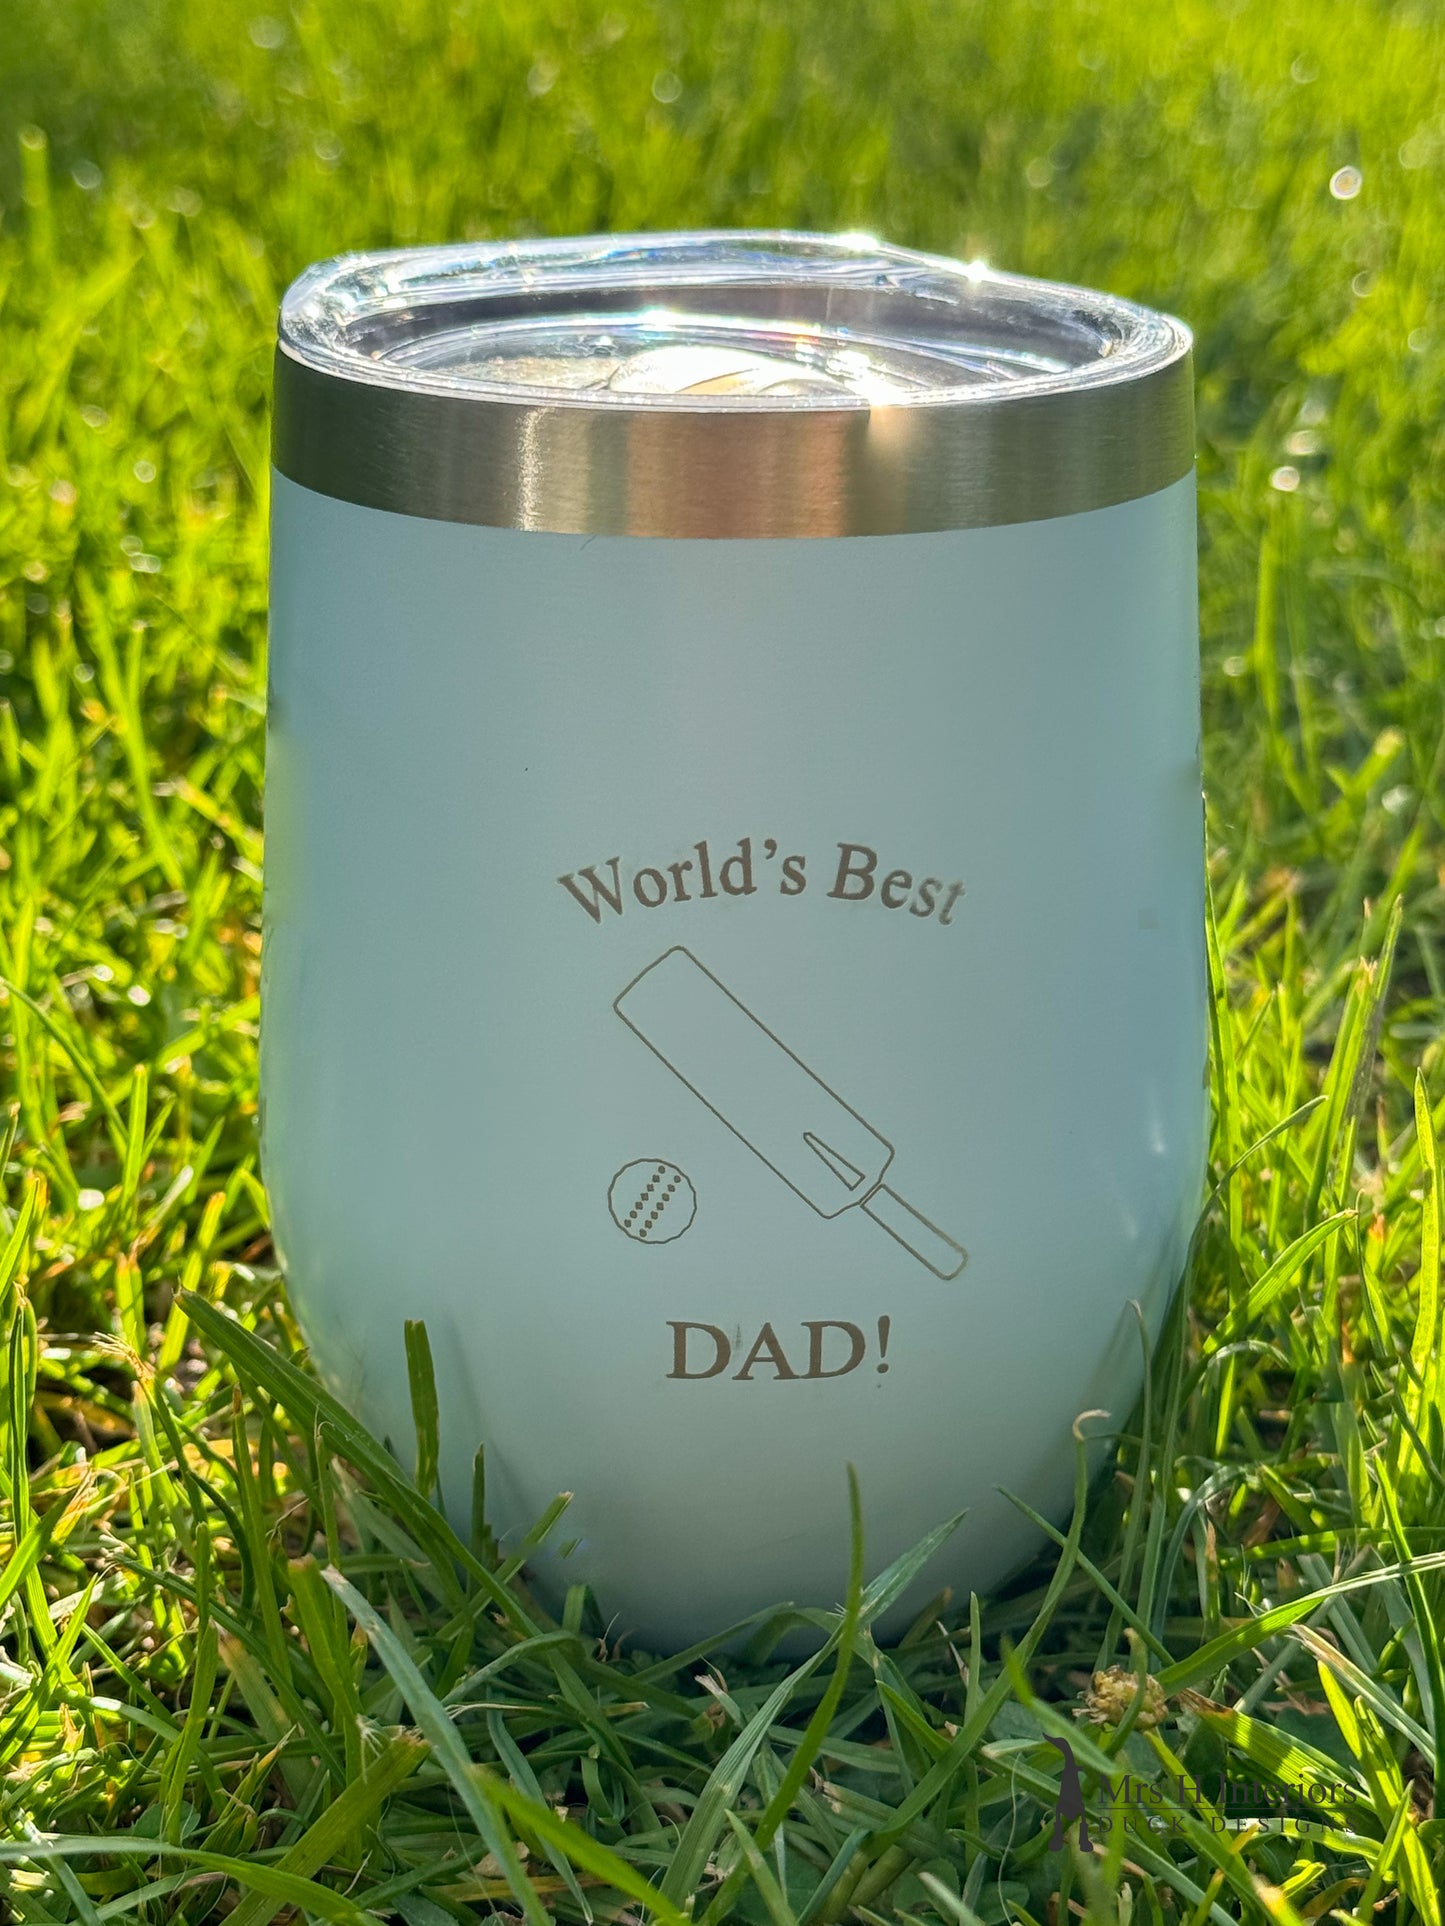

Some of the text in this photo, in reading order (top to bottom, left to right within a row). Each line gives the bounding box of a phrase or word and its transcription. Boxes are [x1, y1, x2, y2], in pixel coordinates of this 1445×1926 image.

[558, 837, 966, 926] World's Best
[666, 1315, 890, 1380] DAD!
